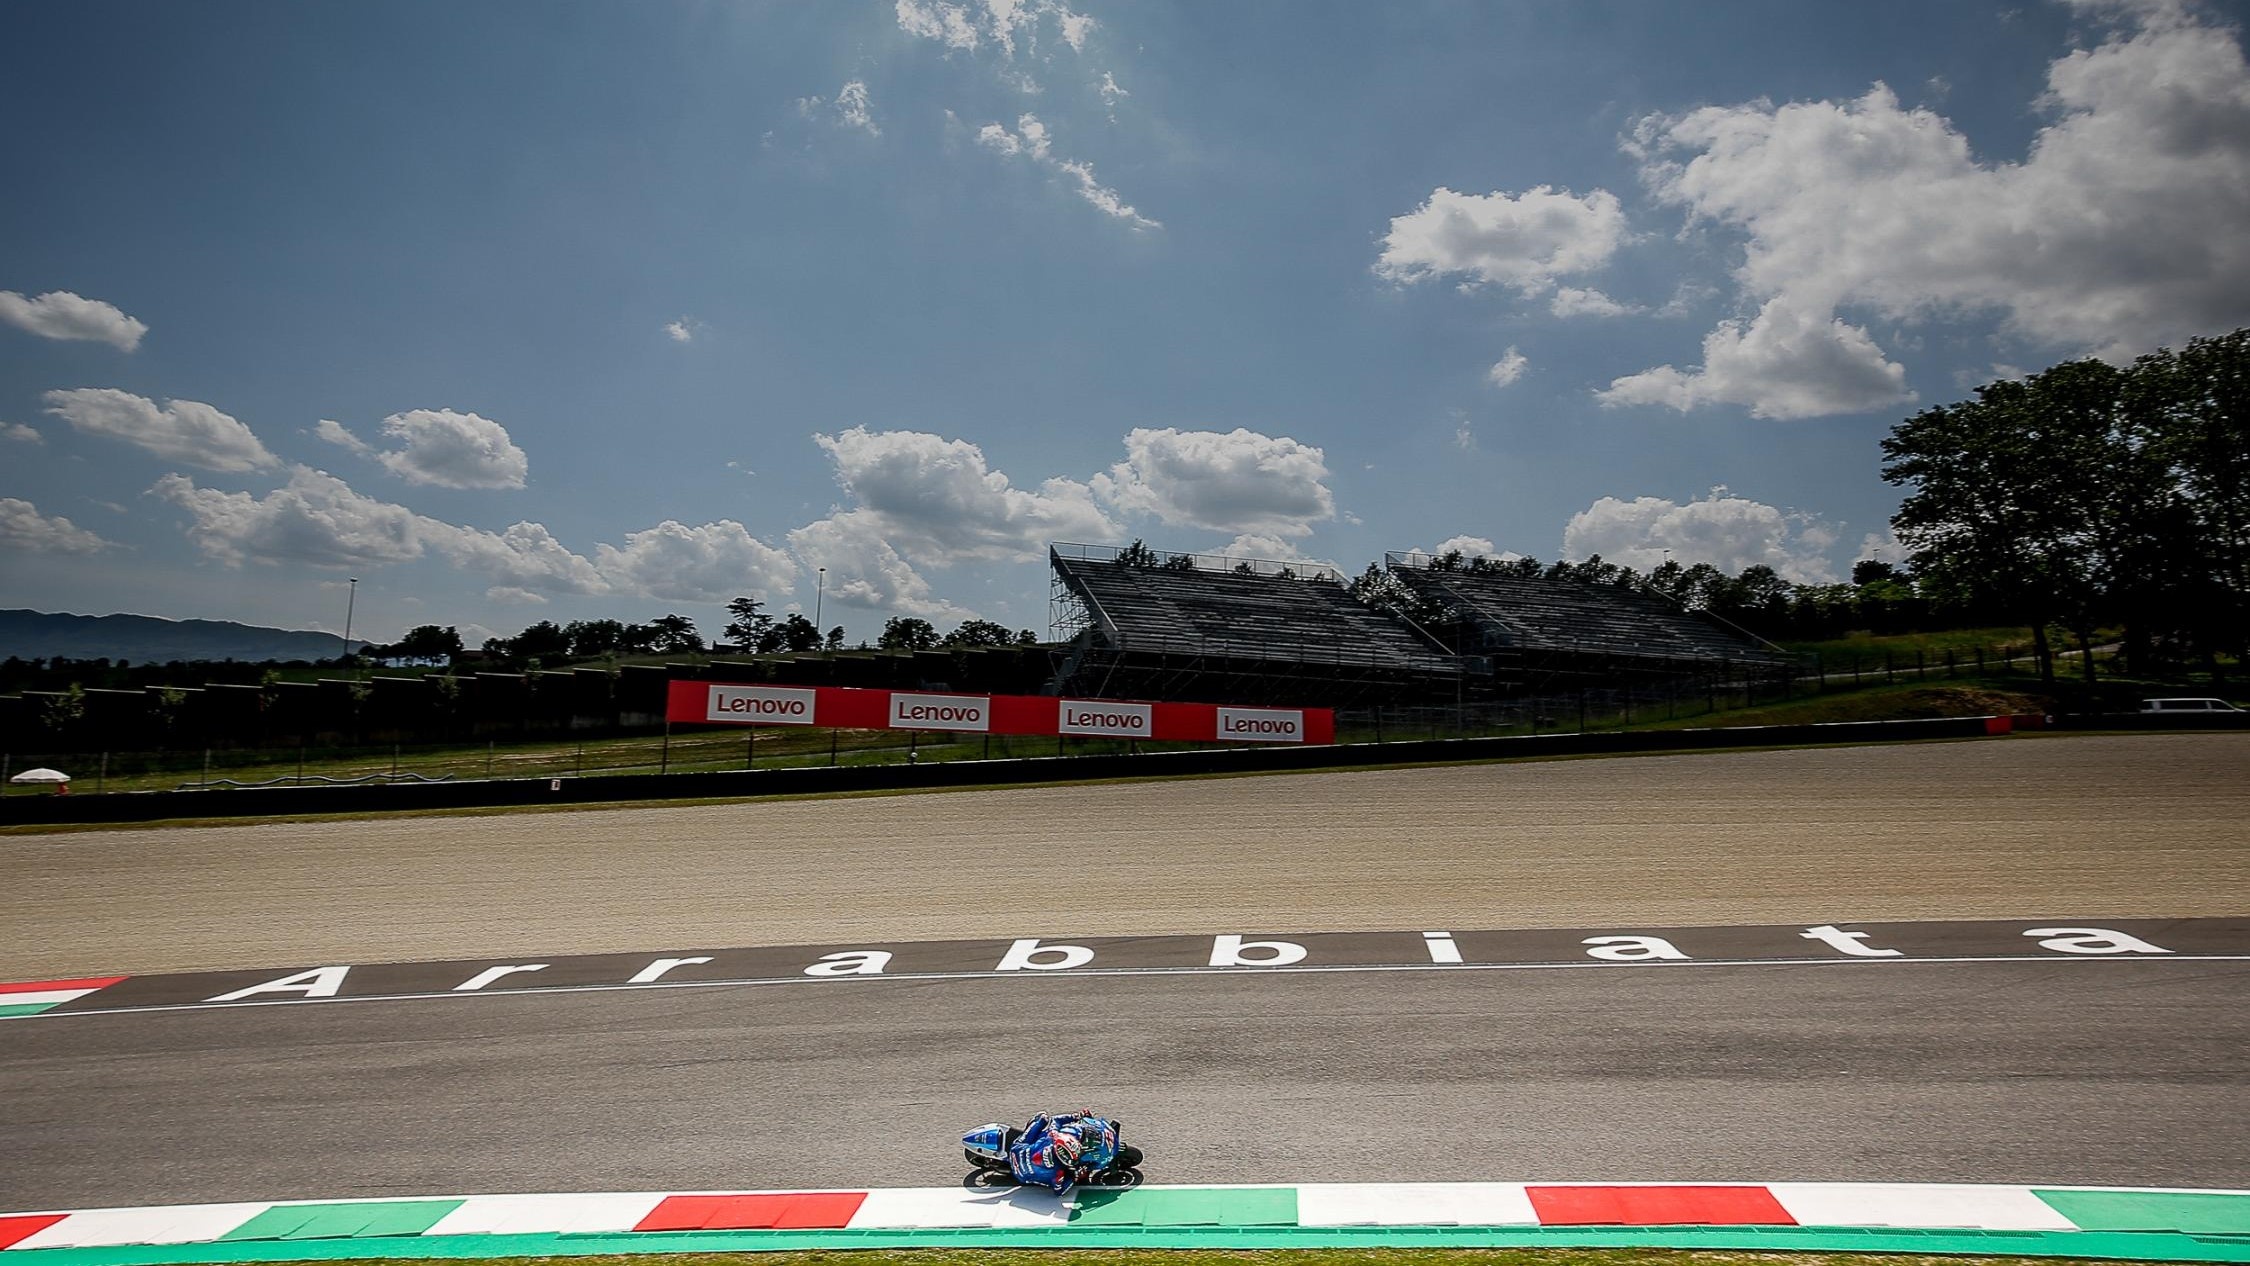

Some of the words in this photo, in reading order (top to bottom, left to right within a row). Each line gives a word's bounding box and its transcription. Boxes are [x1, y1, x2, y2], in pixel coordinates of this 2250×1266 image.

[717, 693, 806, 716] Lenovo
[898, 701, 980, 723] Lenovo
[1066, 708, 1144, 729] Lenovo
[1224, 715, 1296, 734] Lenovo
[204, 926, 2175, 1002] Arrabbiata
